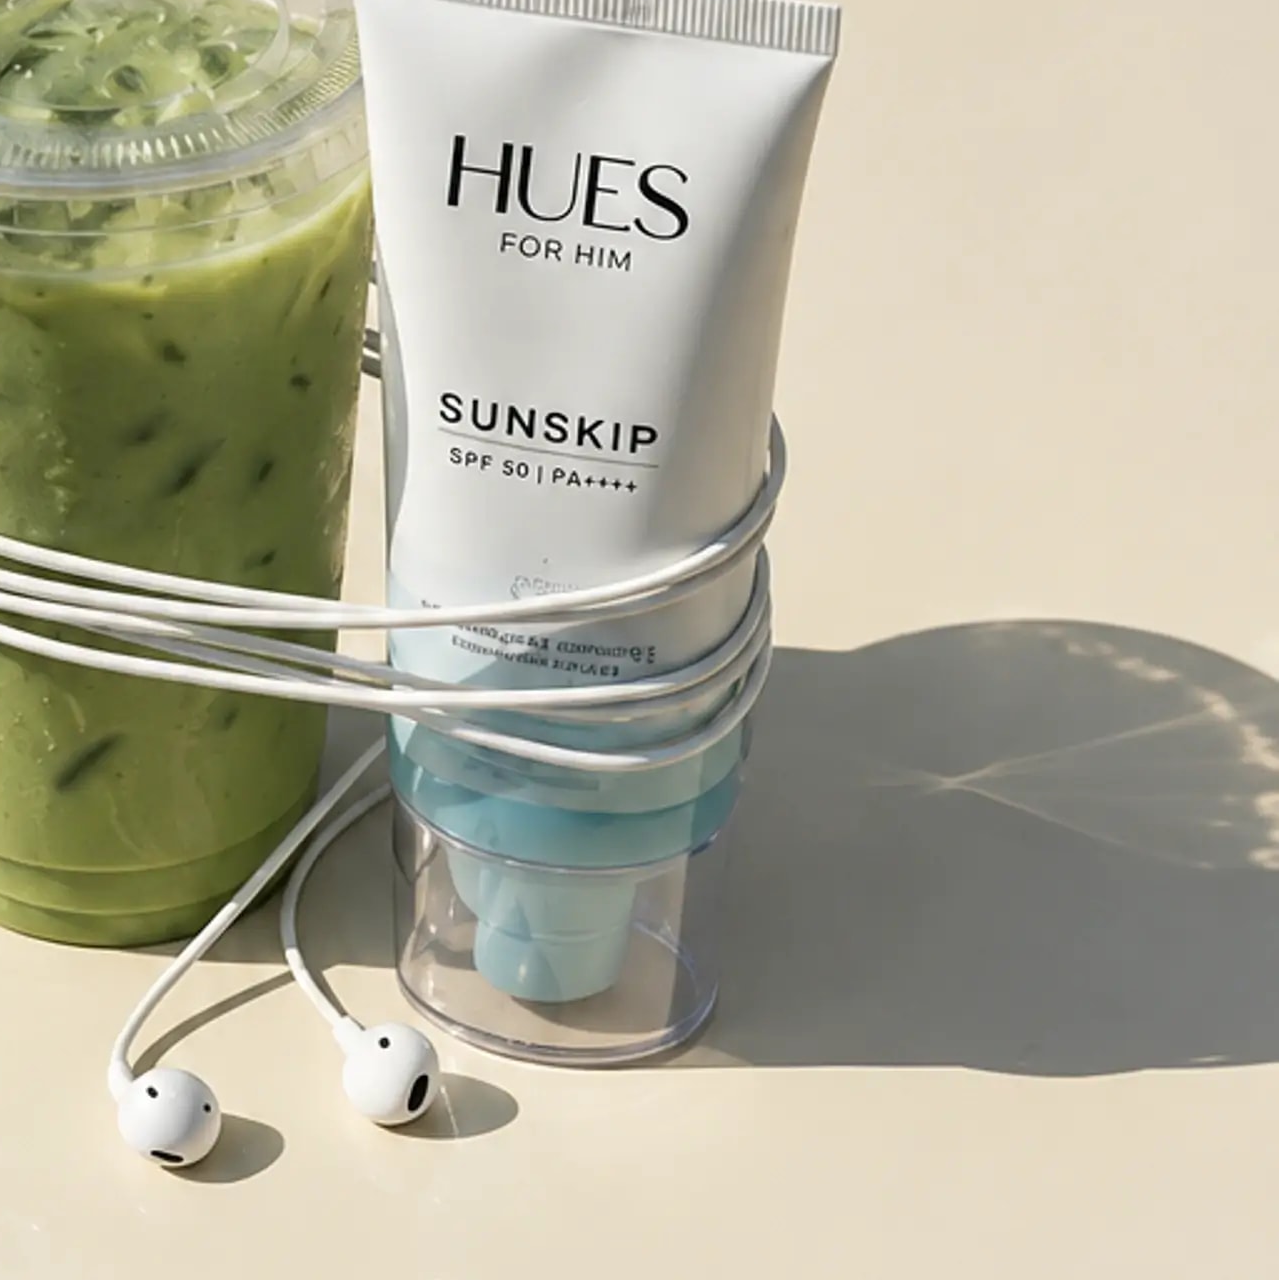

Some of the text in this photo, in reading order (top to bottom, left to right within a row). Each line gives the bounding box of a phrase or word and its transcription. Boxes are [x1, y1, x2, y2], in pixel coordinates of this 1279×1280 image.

[446, 134, 690, 241] HUES
[499, 231, 632, 272] FOR HIM
[439, 392, 660, 454] SUNSKIP
[449, 446, 493, 471] SPF
[502, 459, 530, 479] 50
[551, 467, 638, 494] PA++++
